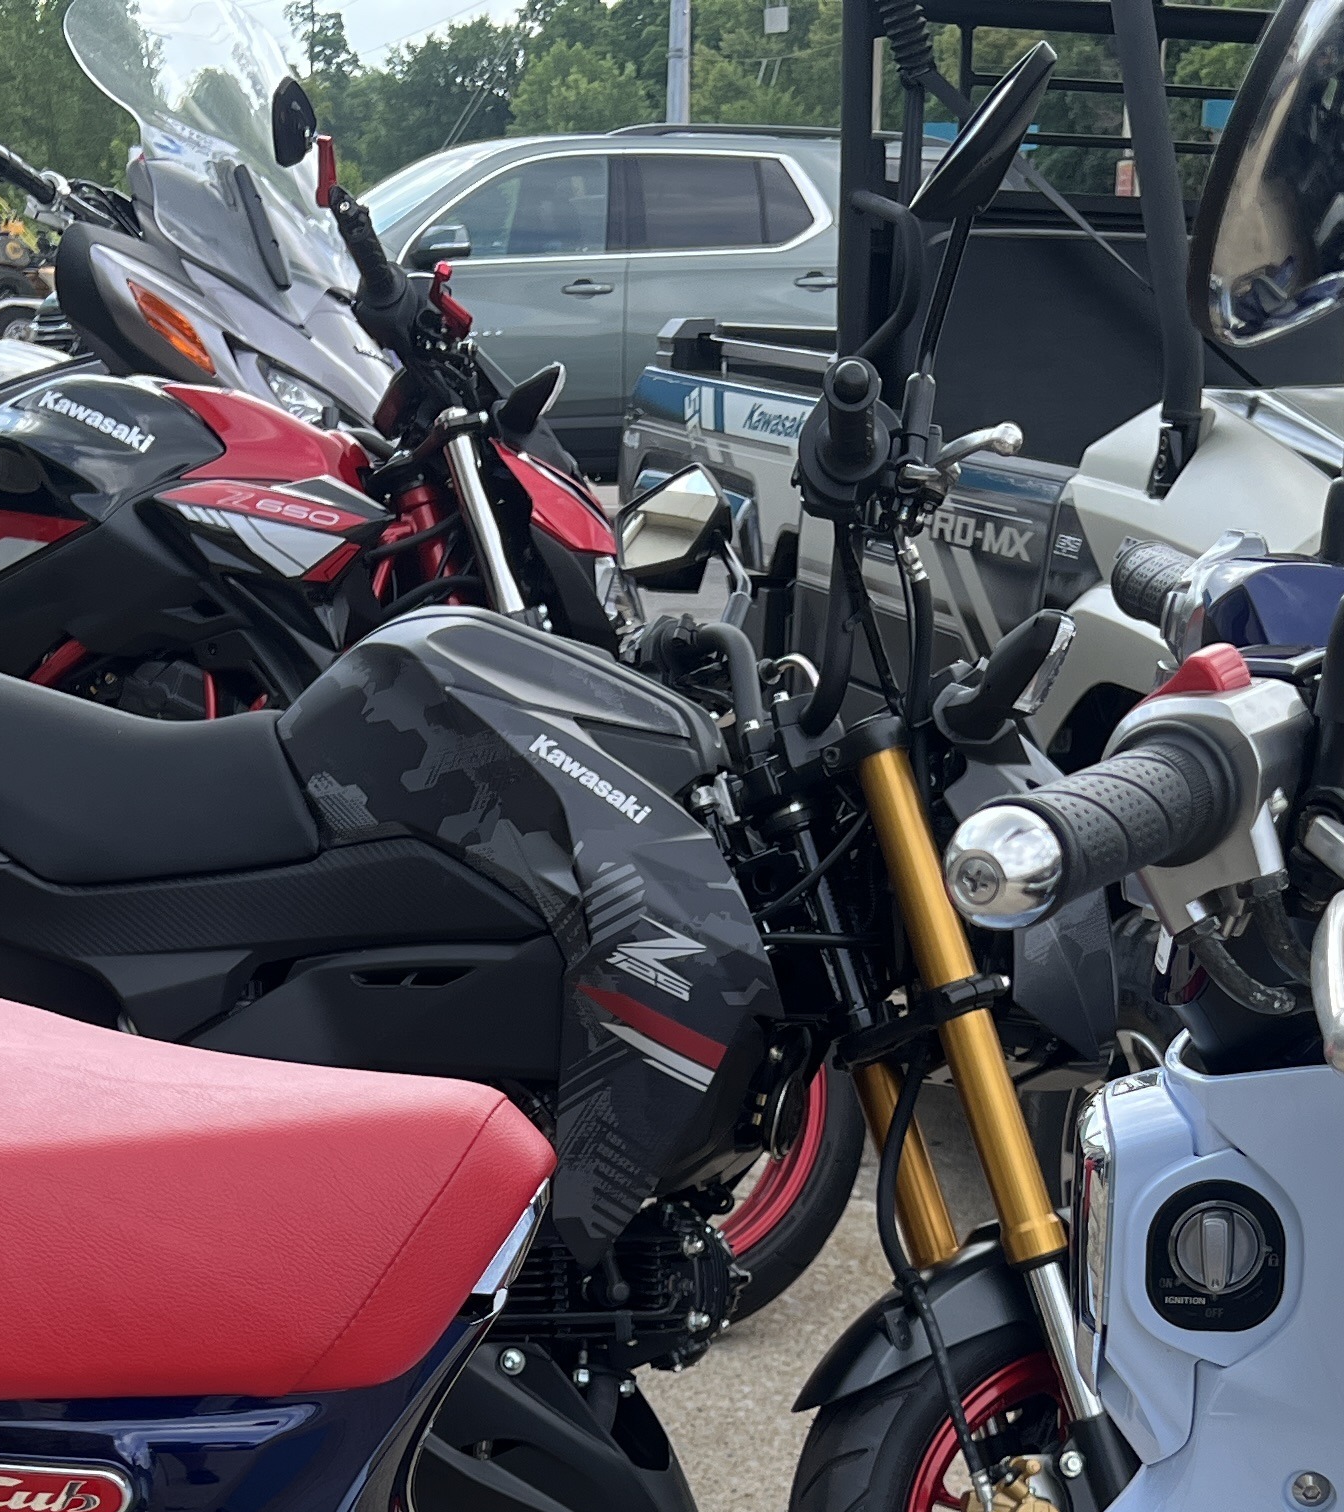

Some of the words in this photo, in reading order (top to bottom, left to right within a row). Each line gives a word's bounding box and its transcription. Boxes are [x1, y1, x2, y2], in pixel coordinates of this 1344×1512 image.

[38, 390, 156, 453] Kawasaki
[742, 402, 807, 439] Kawasak
[528, 734, 652, 824] Kawasaki
[605, 951, 691, 1002] 125
[1164, 1295, 1206, 1305] IGNITION
